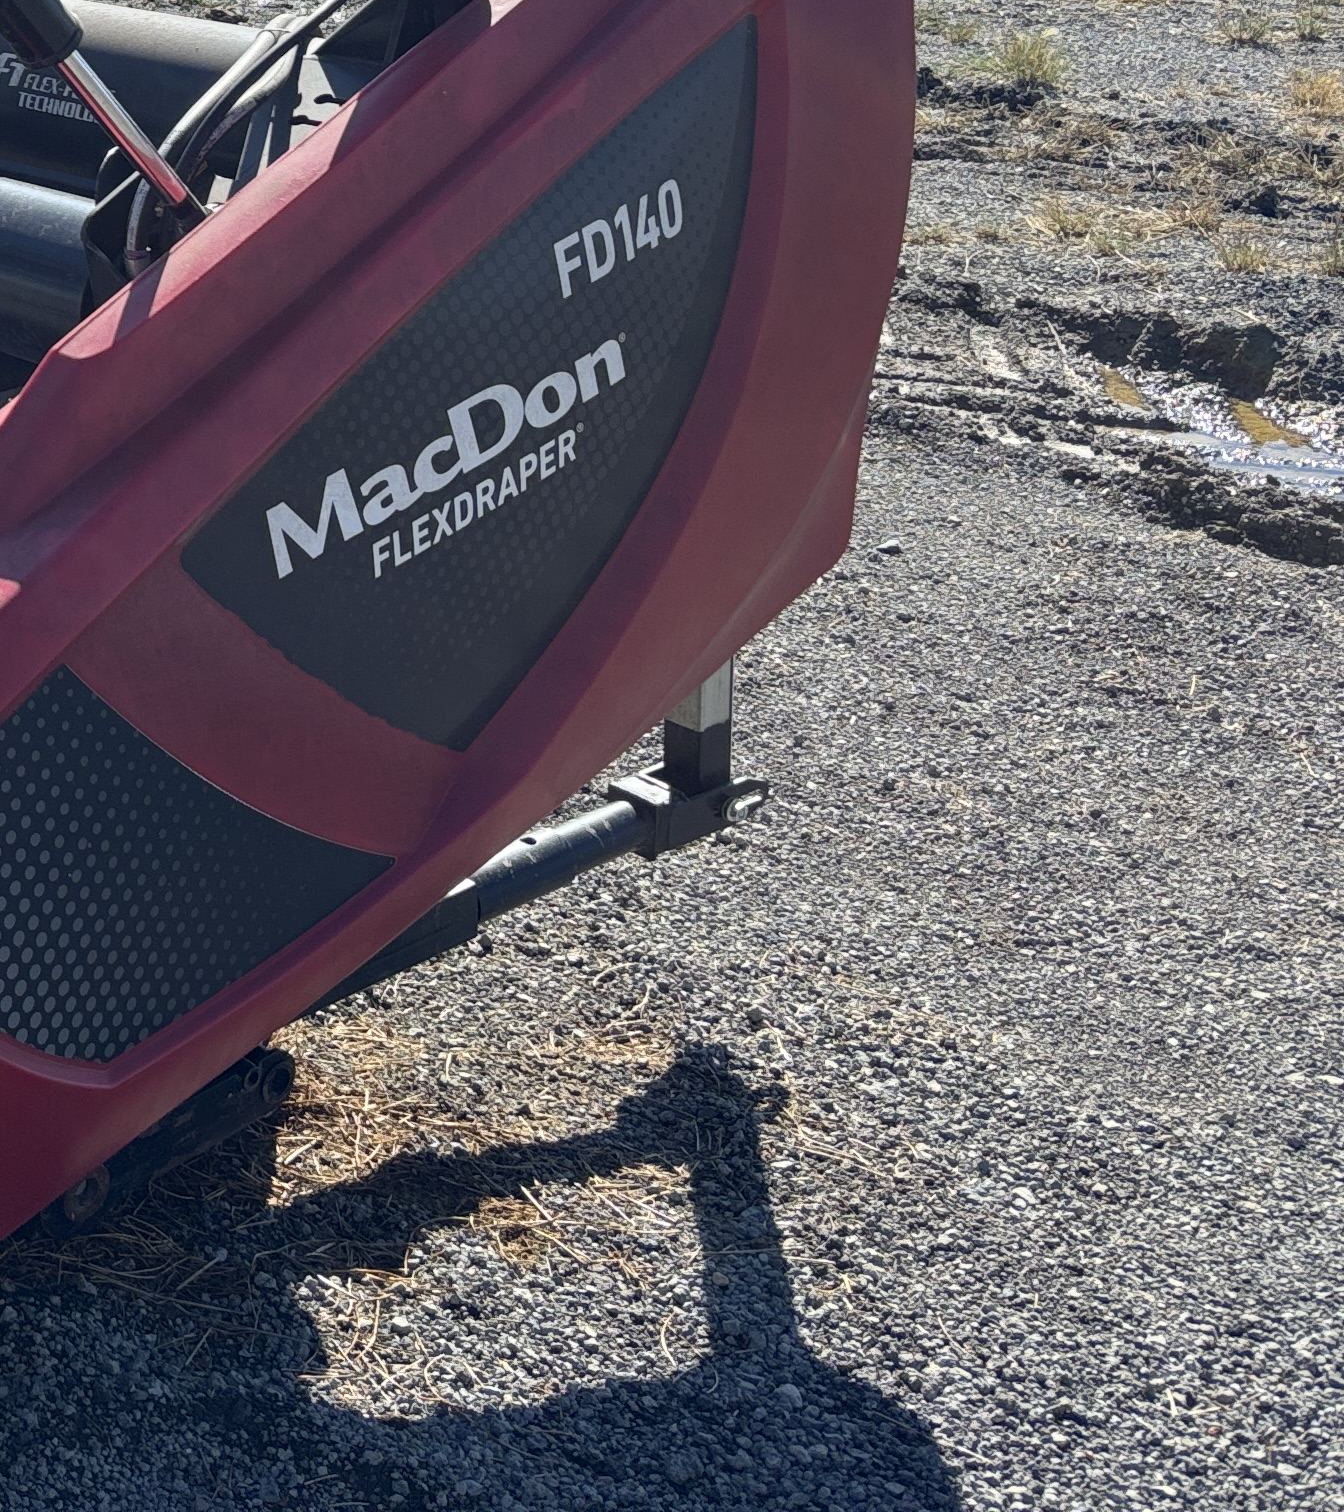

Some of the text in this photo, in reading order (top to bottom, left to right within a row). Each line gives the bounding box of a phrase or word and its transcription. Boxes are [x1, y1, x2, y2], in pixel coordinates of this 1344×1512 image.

[18, 91, 100, 125] TECHNOLO
[553, 179, 683, 300] FD140
[265, 338, 627, 580] MacDon
[372, 428, 577, 579] FLEXDRAPER
